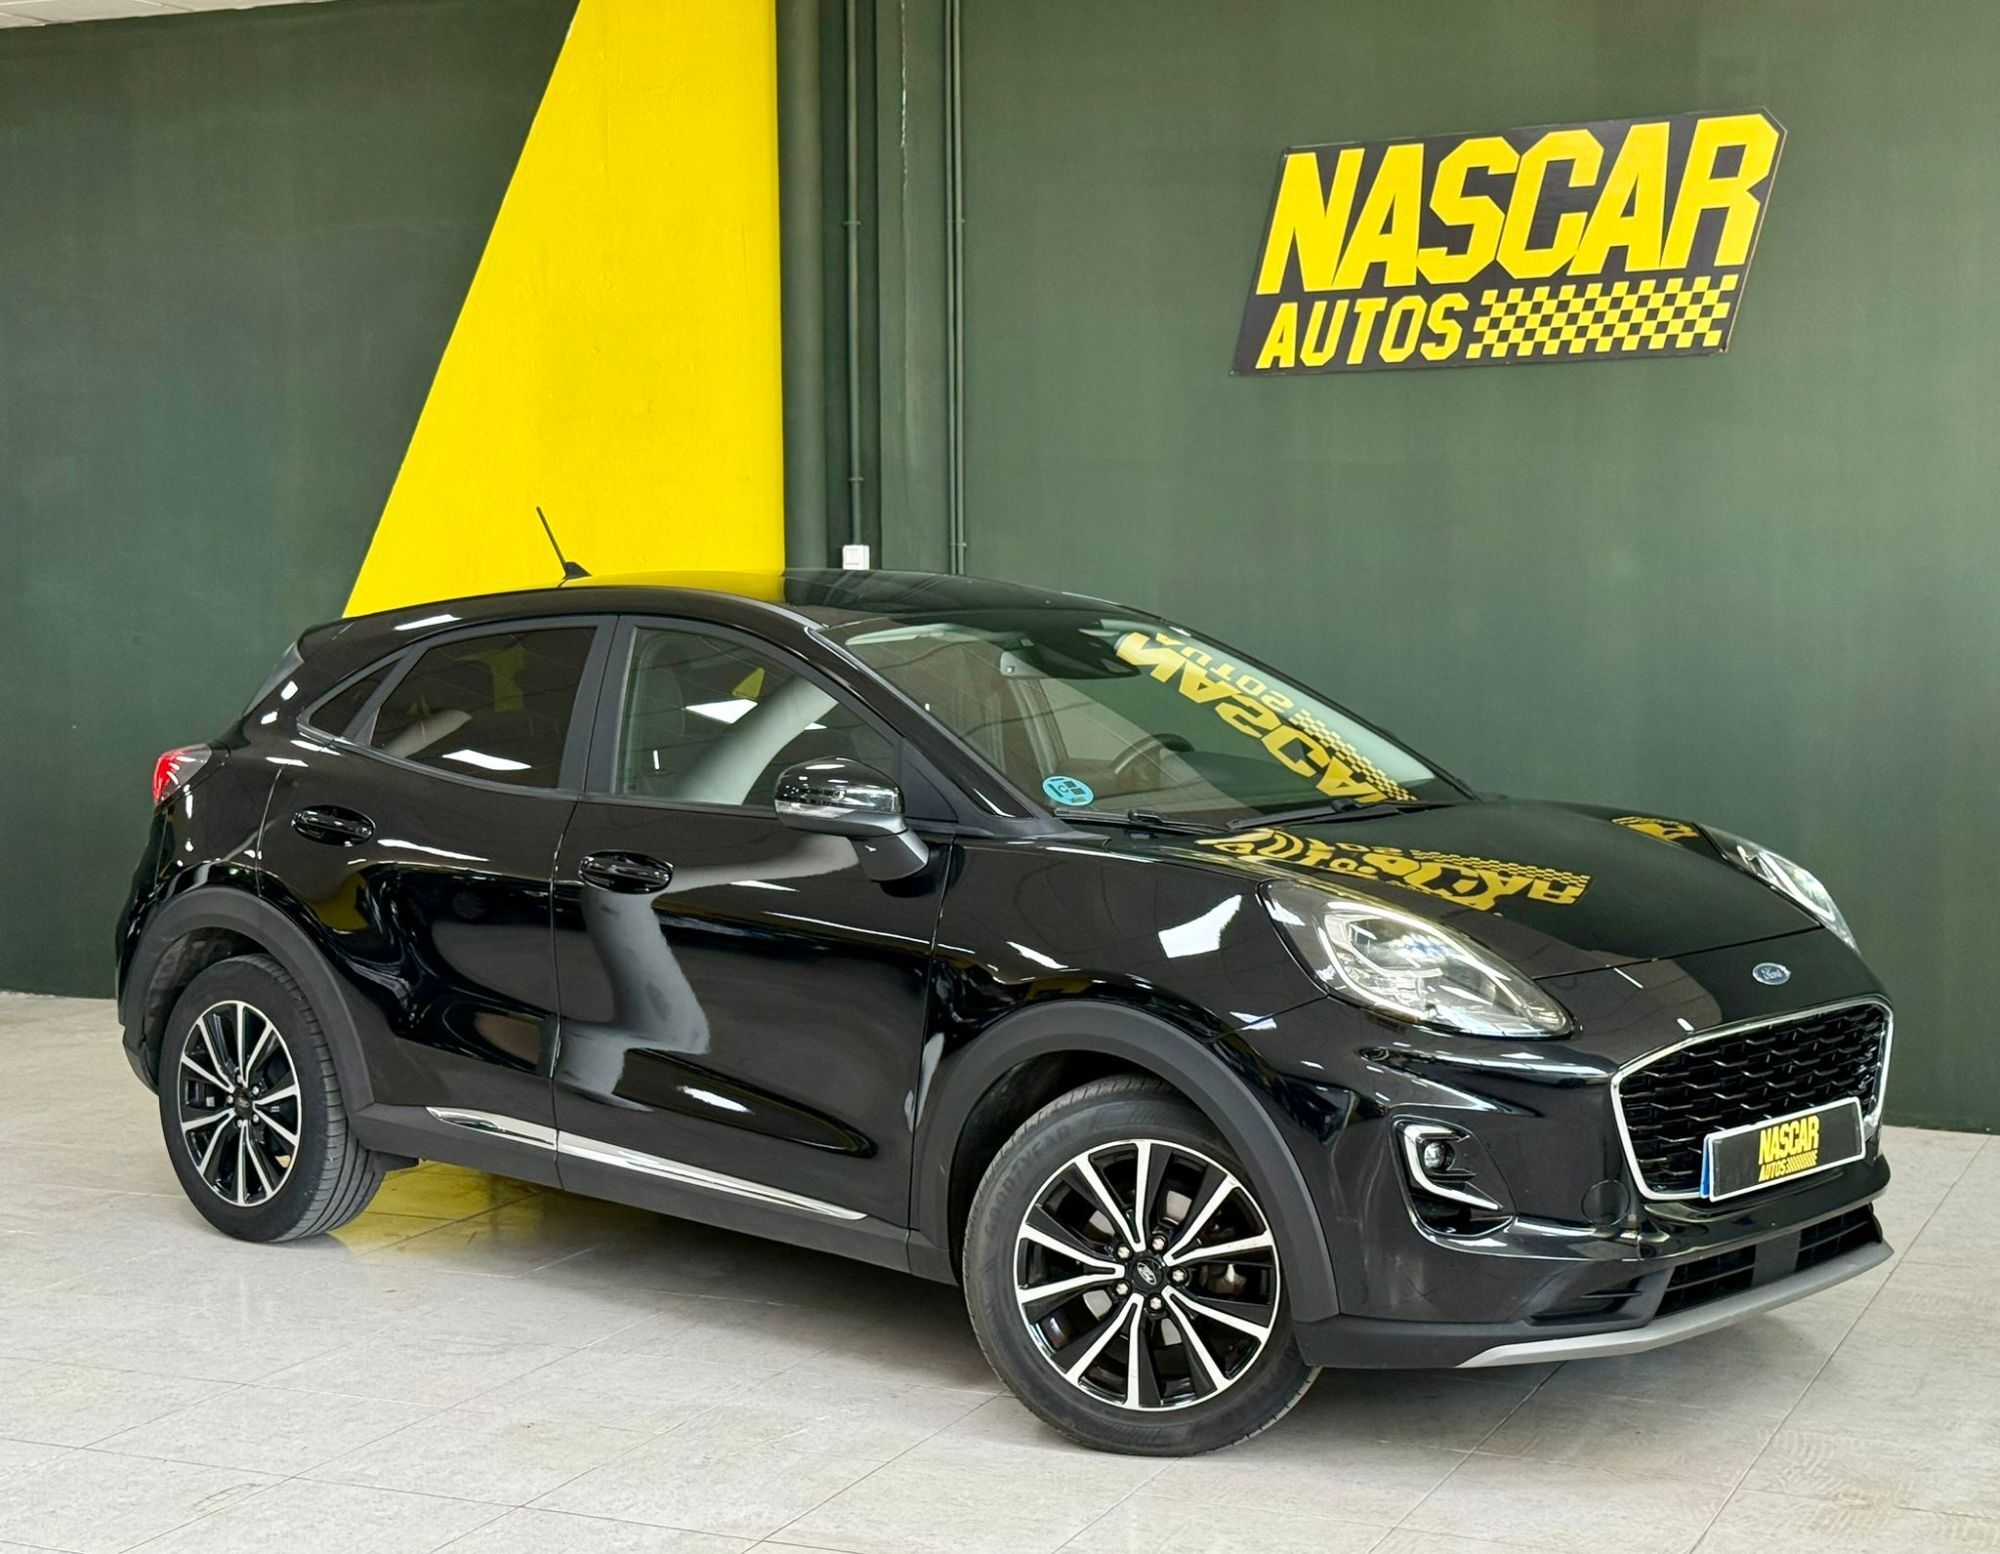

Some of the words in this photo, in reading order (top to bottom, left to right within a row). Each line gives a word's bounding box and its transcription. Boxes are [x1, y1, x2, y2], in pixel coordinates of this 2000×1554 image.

[1256, 114, 1780, 295] NASCAR
[1256, 294, 1469, 369] AUTOS
[1758, 1114, 1820, 1166] NASCAR
[1758, 1158, 1787, 1183] AUTOS
